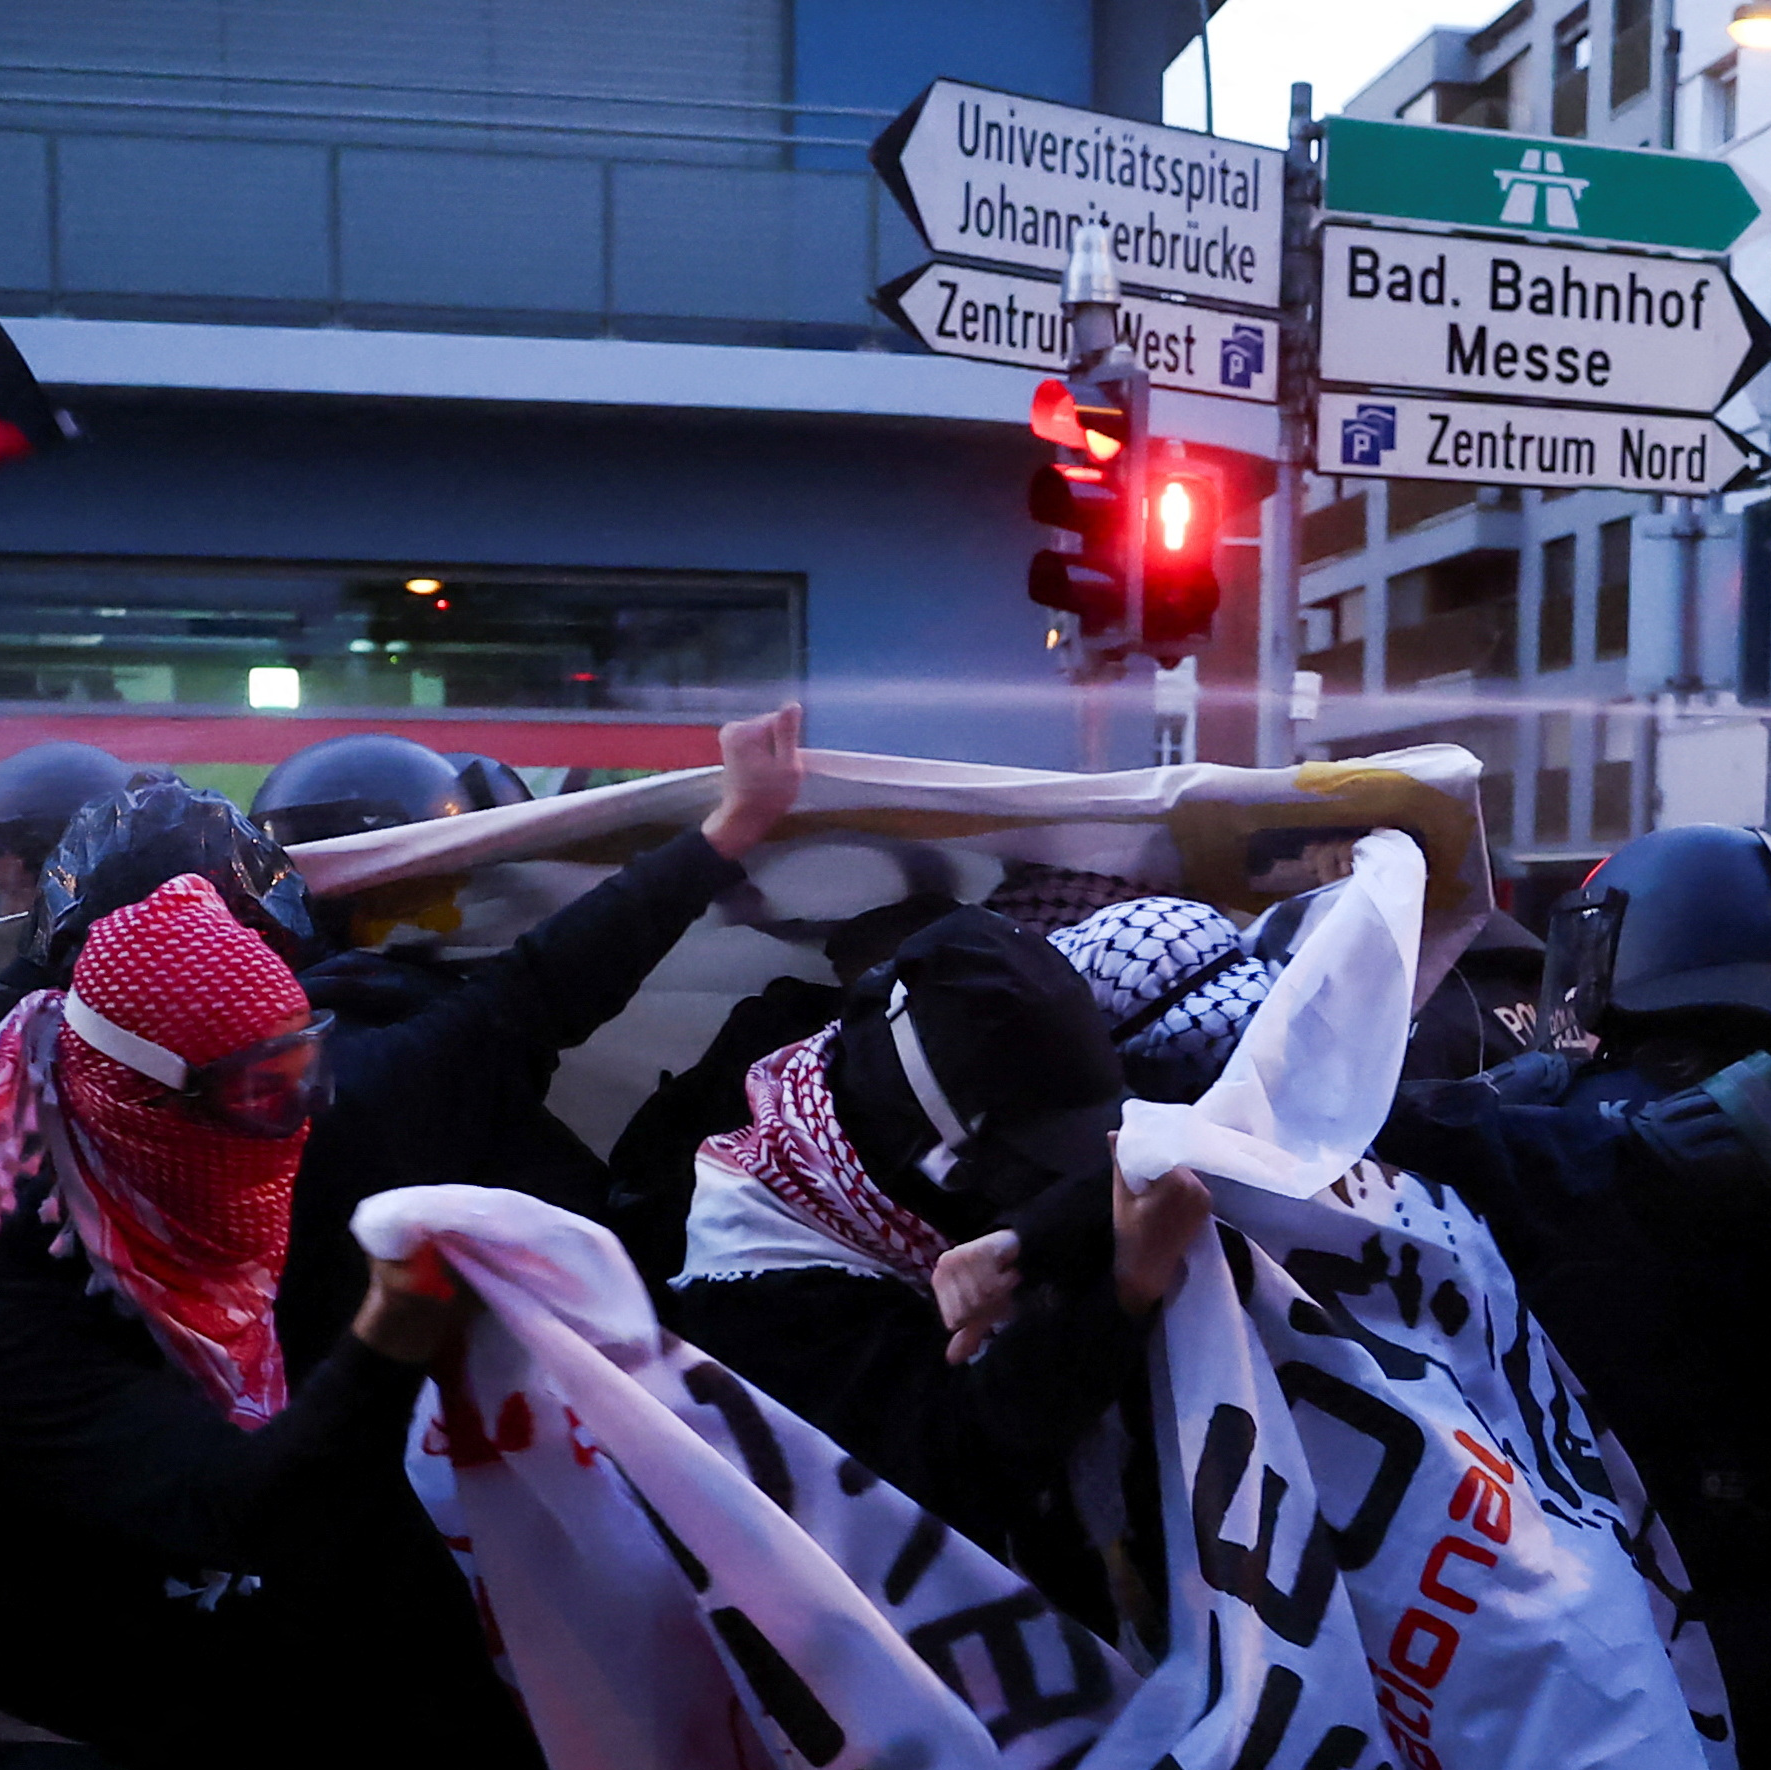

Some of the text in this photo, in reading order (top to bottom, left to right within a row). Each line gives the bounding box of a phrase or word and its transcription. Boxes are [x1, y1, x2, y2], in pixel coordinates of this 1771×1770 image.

[958, 100, 1261, 212] Universitätsspital
[1348, 246, 1711, 332] Bad. Bahnhof
[1112, 309, 1196, 375] West
[1446, 322, 1613, 389] Messe
[1426, 413, 1596, 476] Zentrum
[1619, 427, 1708, 484] Nord
